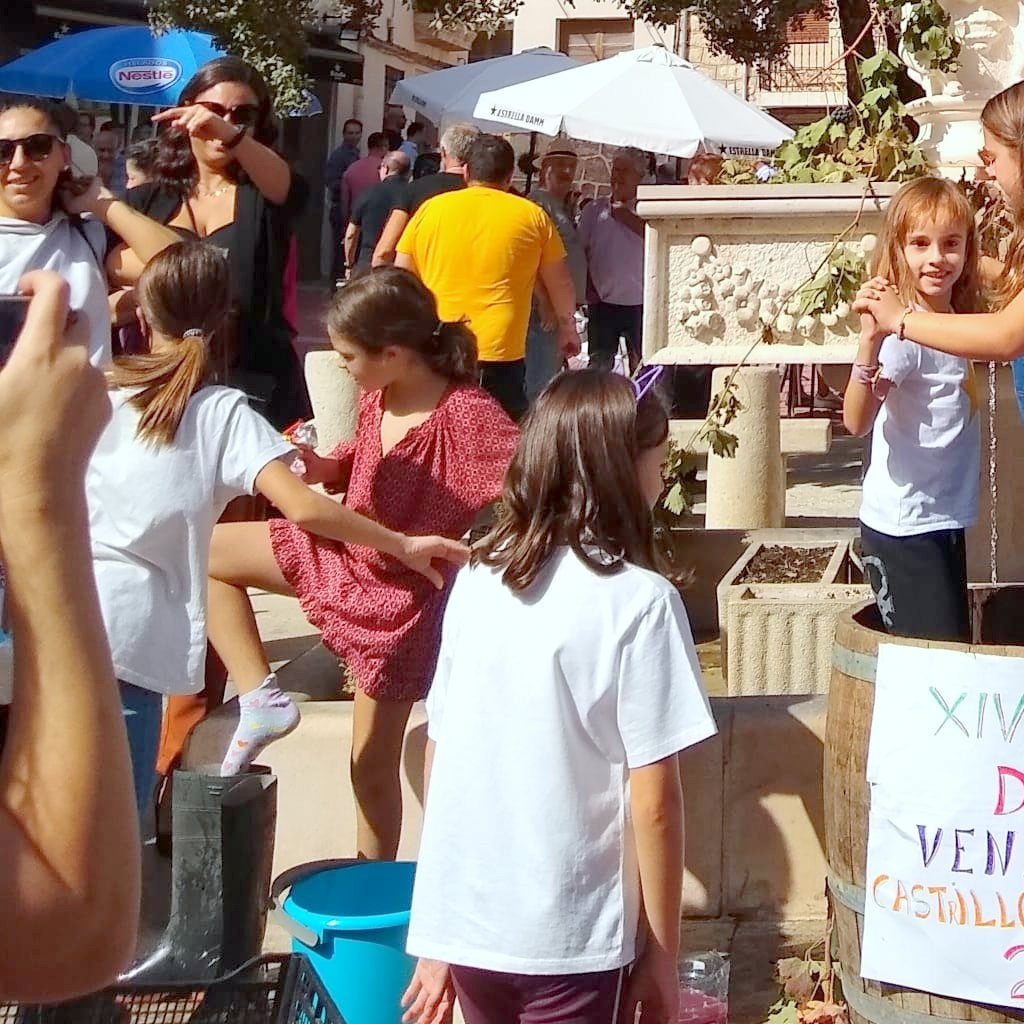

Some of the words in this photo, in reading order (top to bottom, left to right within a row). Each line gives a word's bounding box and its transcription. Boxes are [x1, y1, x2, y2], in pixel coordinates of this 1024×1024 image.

[496, 108, 525, 122] ESTRELLA
[525, 115, 545, 127] DAMM
[729, 146, 760, 156] ESTRELLA
